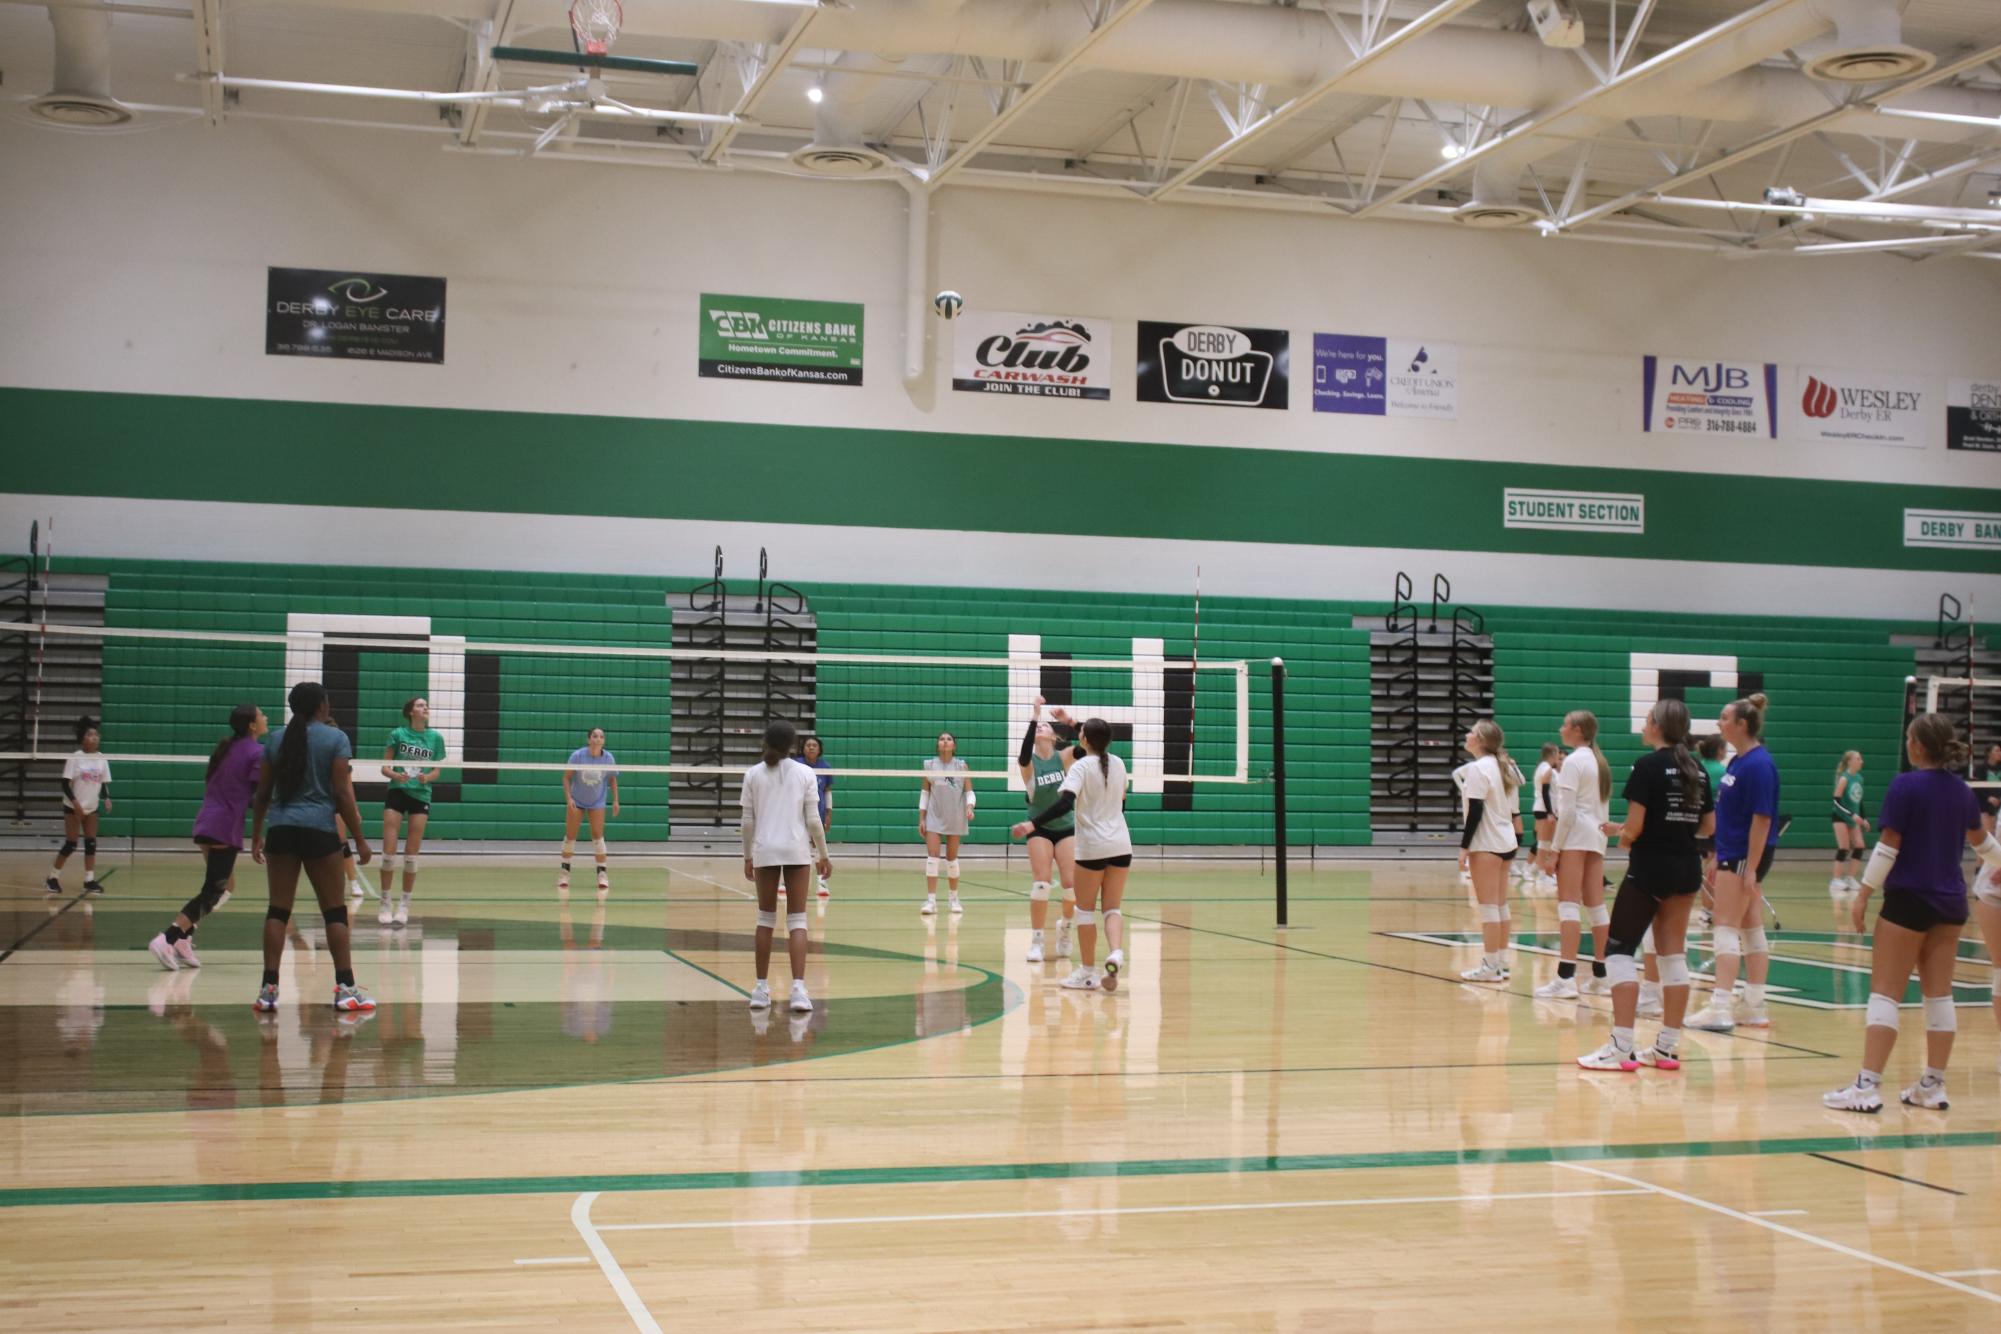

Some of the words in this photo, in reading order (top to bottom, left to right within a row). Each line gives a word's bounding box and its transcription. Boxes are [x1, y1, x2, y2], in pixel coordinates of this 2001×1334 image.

[276, 301, 340, 317] DERBY
[345, 305, 380, 318] EYE
[386, 308, 437, 322] CARE
[322, 321, 357, 331] LOGAN
[768, 319, 822, 334] CITIZENS
[825, 323, 856, 337] BANK
[801, 334, 856, 344] KANSAS
[1188, 331, 1237, 354] DERBY
[728, 344, 777, 355] Hometown
[778, 345, 838, 358] Commitment.
[976, 335, 1090, 373] Club
[1338, 350, 1354, 359] here
[1356, 351, 1366, 360] for
[1367, 353, 1384, 362] you.
[717, 364, 848, 381] CitizensBankofKansas.com
[973, 369, 1088, 385] CARWASH
[1181, 358, 1255, 383] DONUT
[1672, 362, 1750, 393] MJB
[983, 382, 1013, 393] JOIN
[1018, 384, 1041, 395] THE
[1045, 386, 1081, 397] CLUB!
[1716, 397, 1751, 406] COOLING
[1840, 388, 1922, 411] WESLEY
[1840, 407, 1873, 423] Derby
[1876, 409, 1892, 422] ER
[1508, 500, 1575, 519] STUDENT
[1578, 503, 1640, 521] SECTION
[1921, 521, 1965, 538] DERBY
